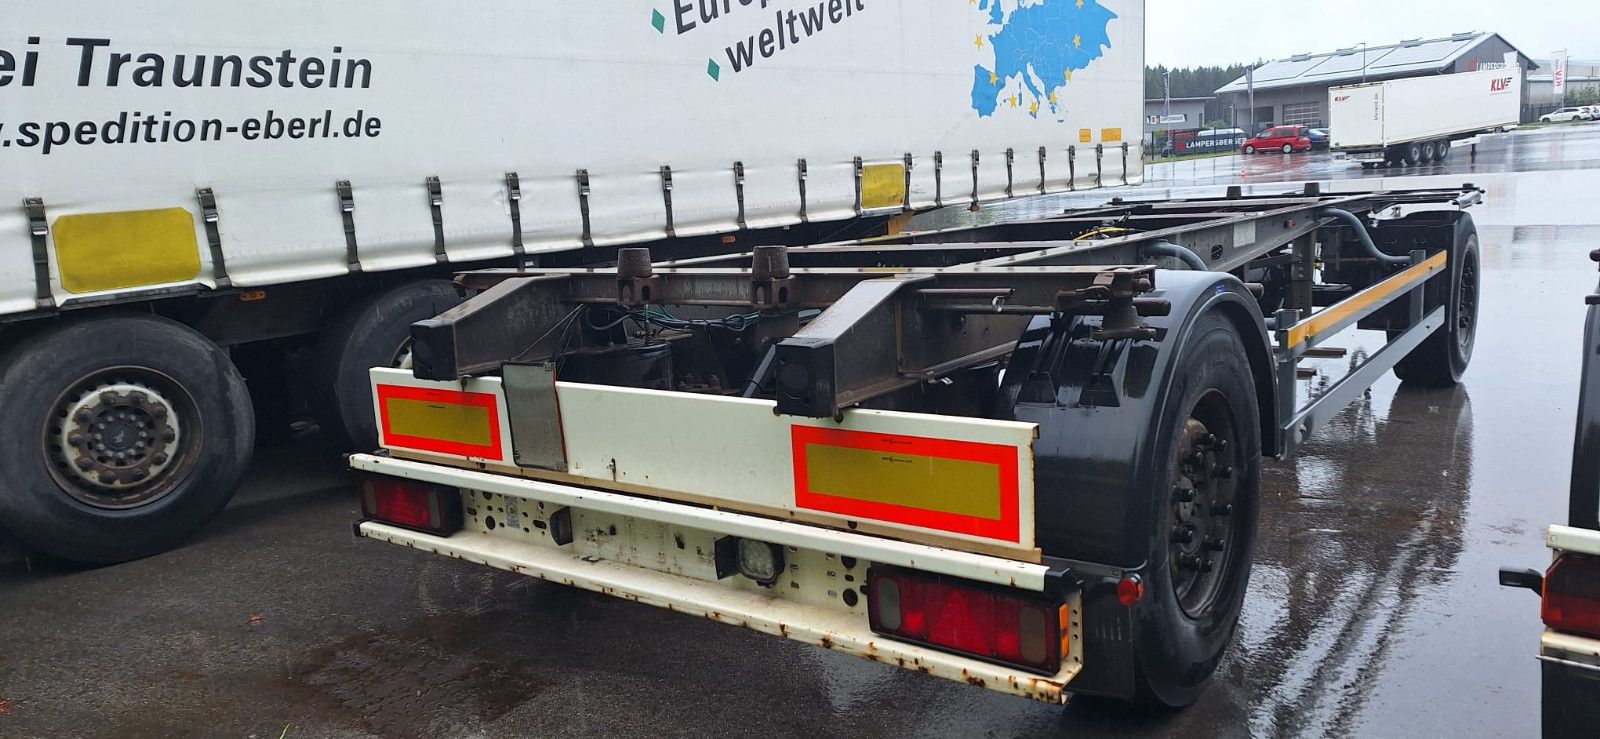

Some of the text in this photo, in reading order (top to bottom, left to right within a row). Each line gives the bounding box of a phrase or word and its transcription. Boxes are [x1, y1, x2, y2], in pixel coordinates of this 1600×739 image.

[66, 37, 372, 89] Traunstein
[1490, 78, 1509, 91] KLV
[0, 110, 381, 155] .spedition-eberl.de
